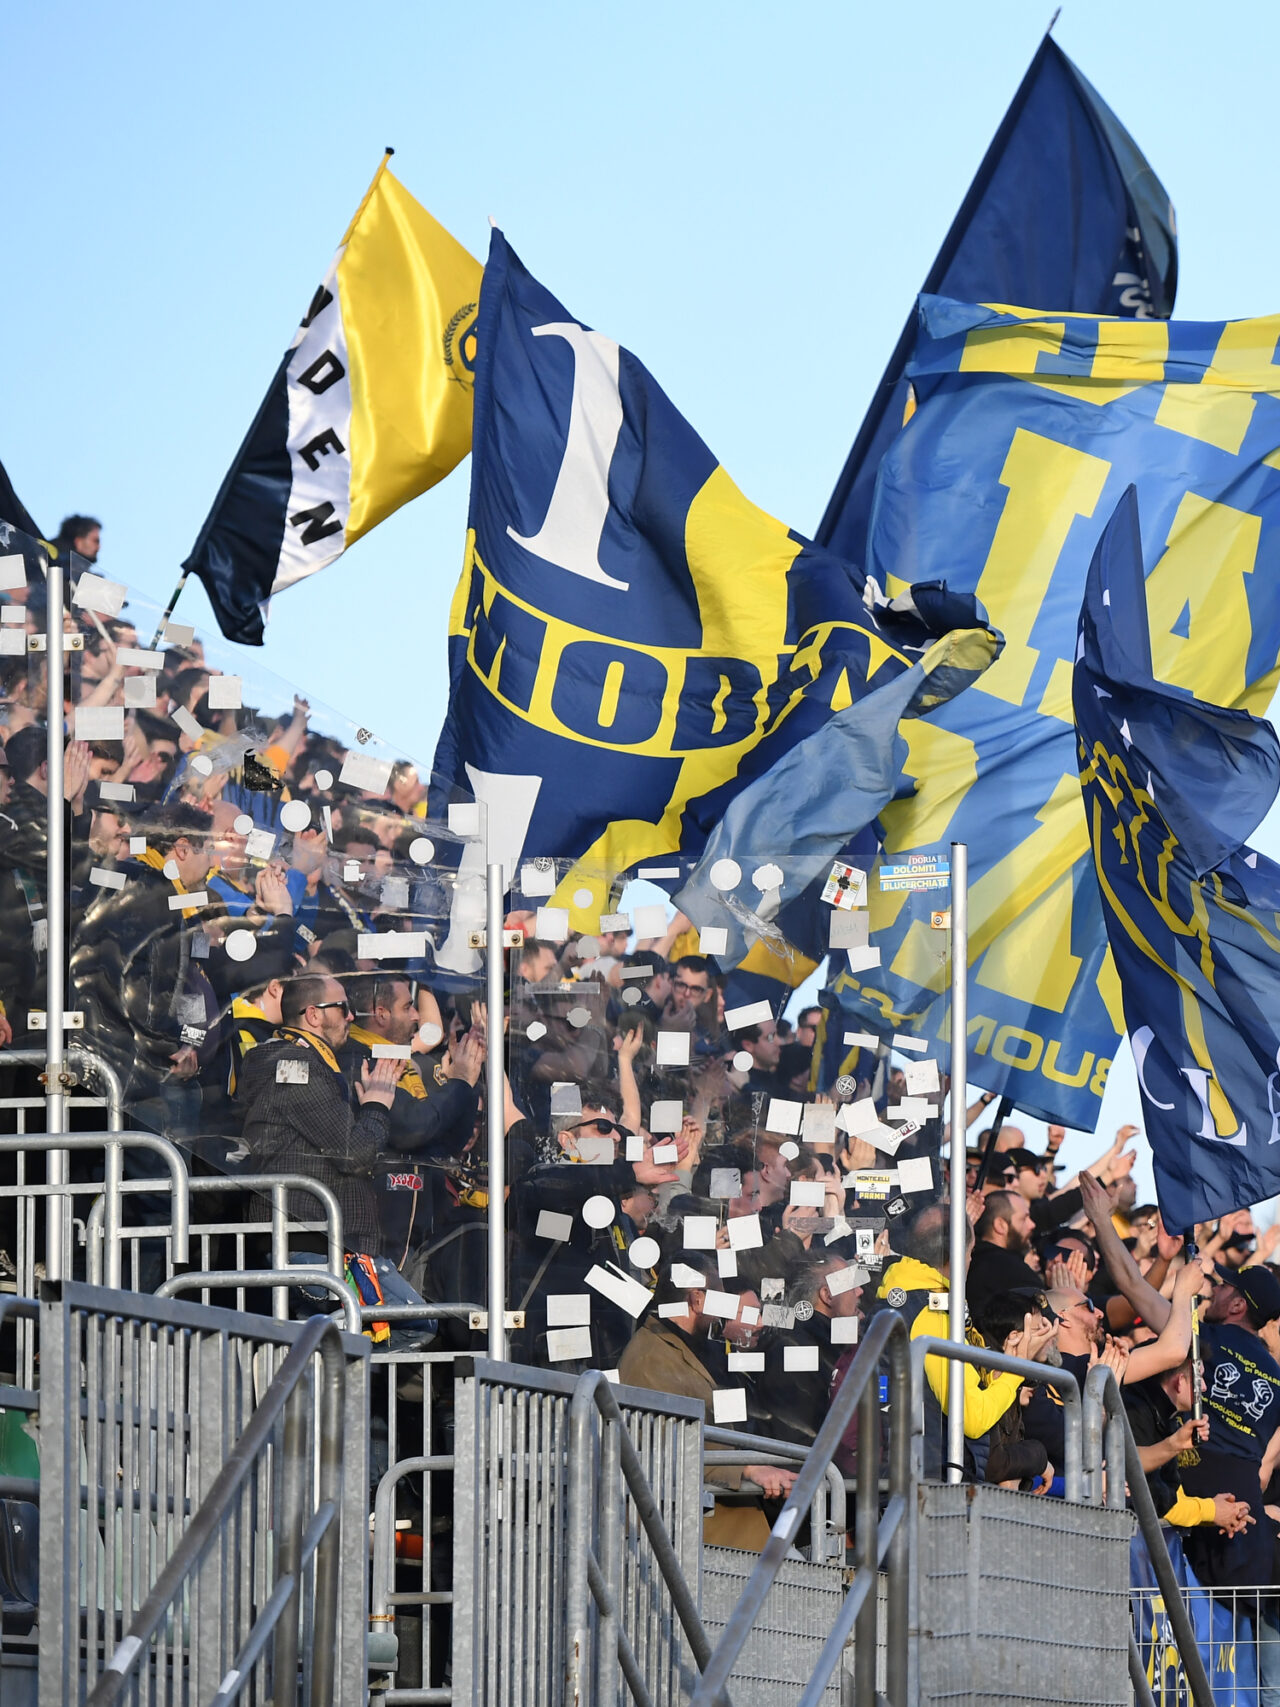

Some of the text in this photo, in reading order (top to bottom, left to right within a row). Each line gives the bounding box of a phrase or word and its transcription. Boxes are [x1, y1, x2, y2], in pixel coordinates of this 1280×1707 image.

[893, 864, 936, 874] DOLOMITI
[856, 1175, 890, 1183] MONTICELLI
[858, 1191, 887, 1200] PARMA
[1235, 1352, 1257, 1368] TEMPO
[1254, 1370, 1280, 1387] PAGARE
[1209, 1400, 1243, 1422] VOGLIONO
